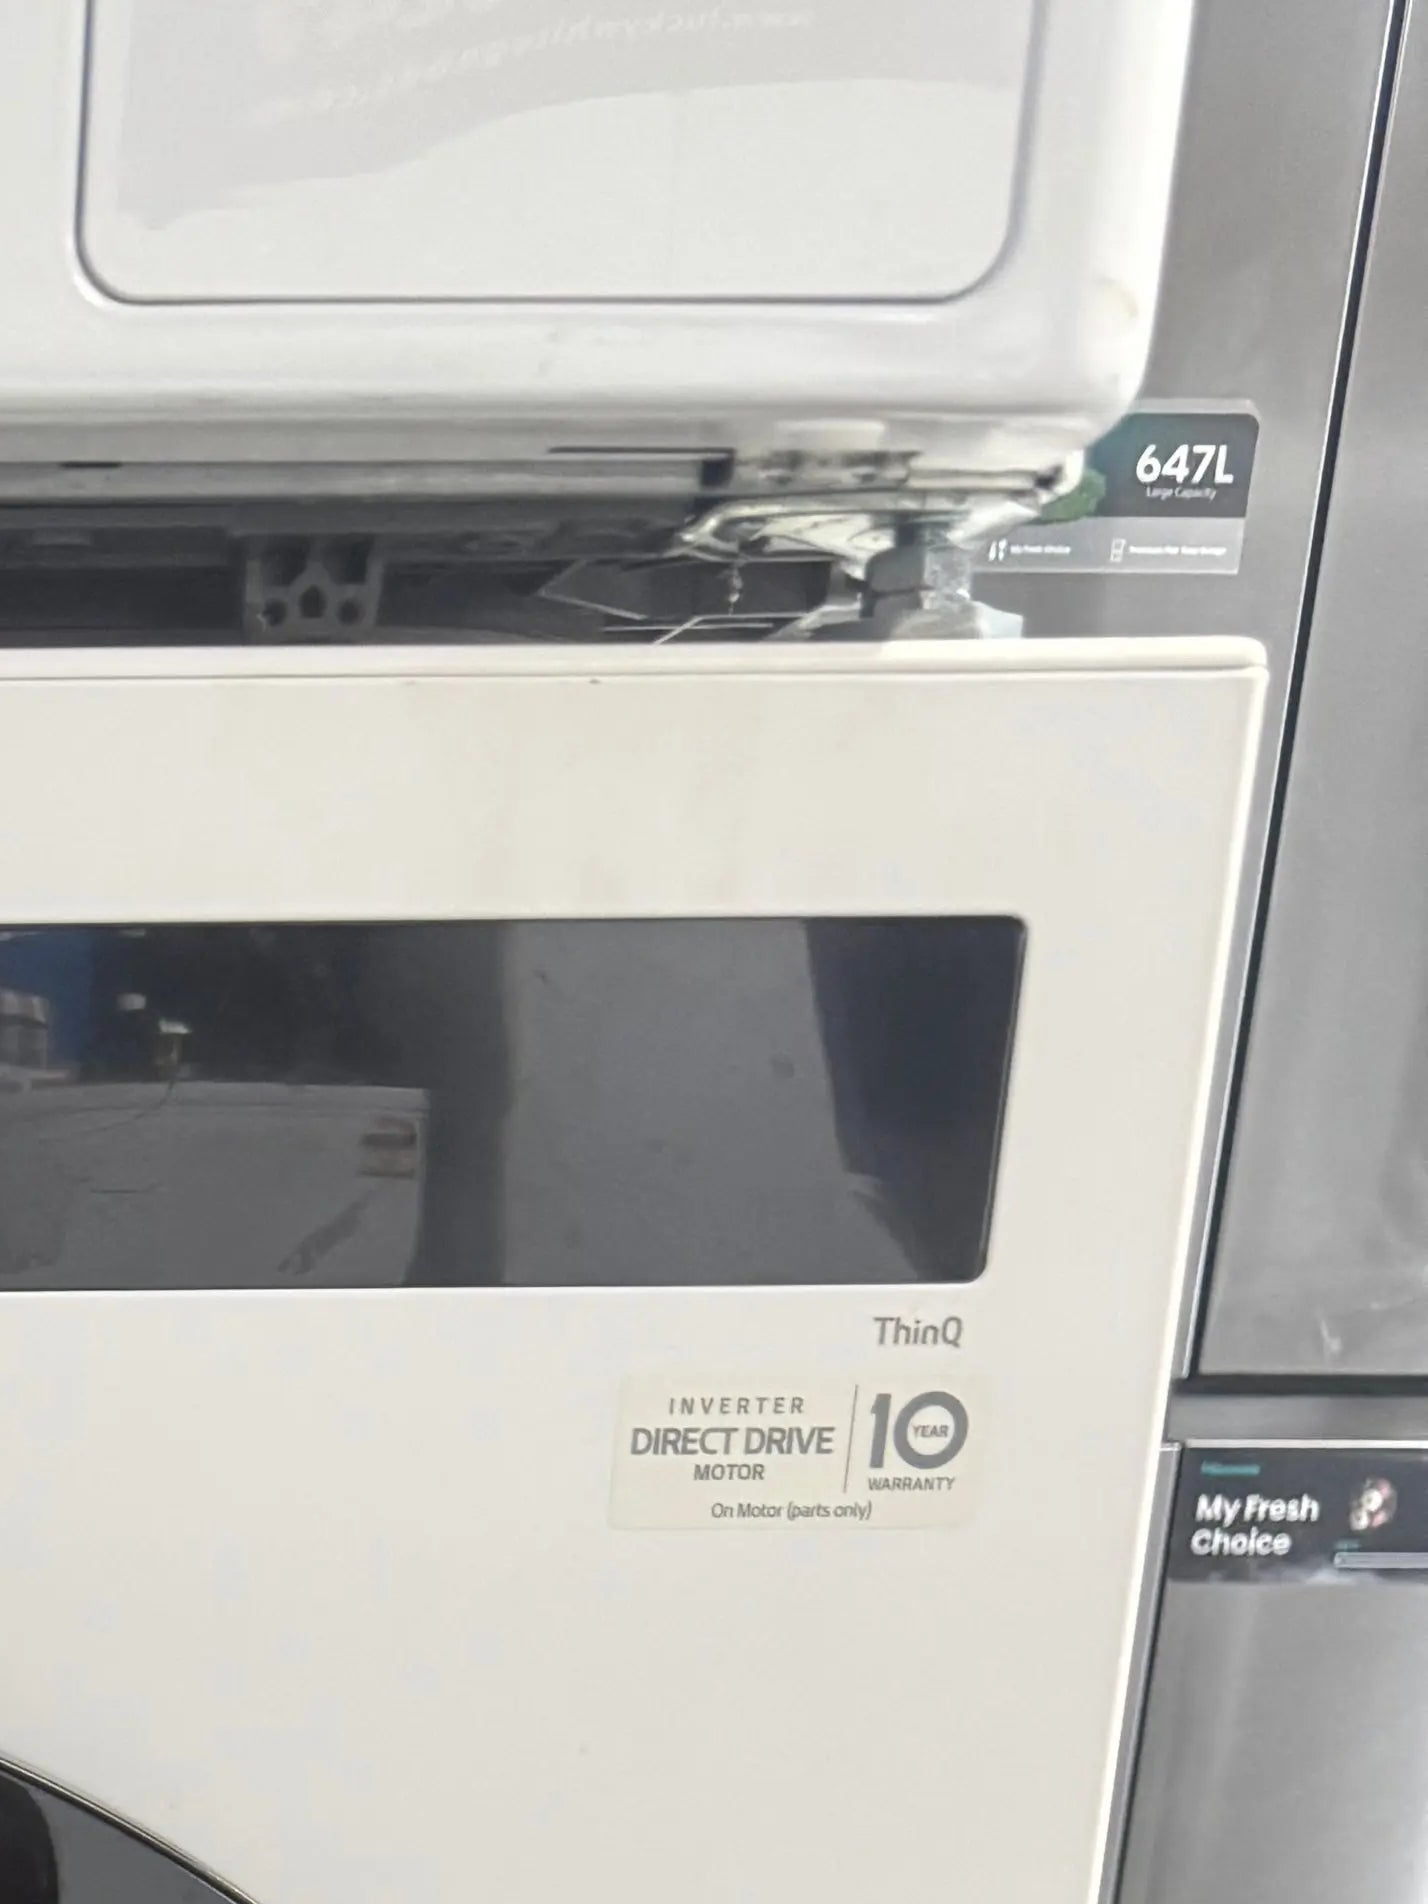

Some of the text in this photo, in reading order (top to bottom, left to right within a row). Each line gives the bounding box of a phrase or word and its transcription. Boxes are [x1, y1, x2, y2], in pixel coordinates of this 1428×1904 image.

[1136, 443, 1234, 485] 647L
[873, 1316, 963, 1347] ThinQ
[669, 1397, 804, 1415] INVERTER
[631, 1427, 835, 1455] DIRECT DRIVE
[869, 1390, 969, 1470] 10
[913, 1424, 949, 1439] YEAR
[693, 1464, 765, 1481] MOTOR
[868, 1476, 955, 1492] WARRANTY
[711, 1501, 872, 1521] On Motor (parts only)
[1195, 1493, 1320, 1527] My Fresh
[1190, 1526, 1292, 1556] Choice
